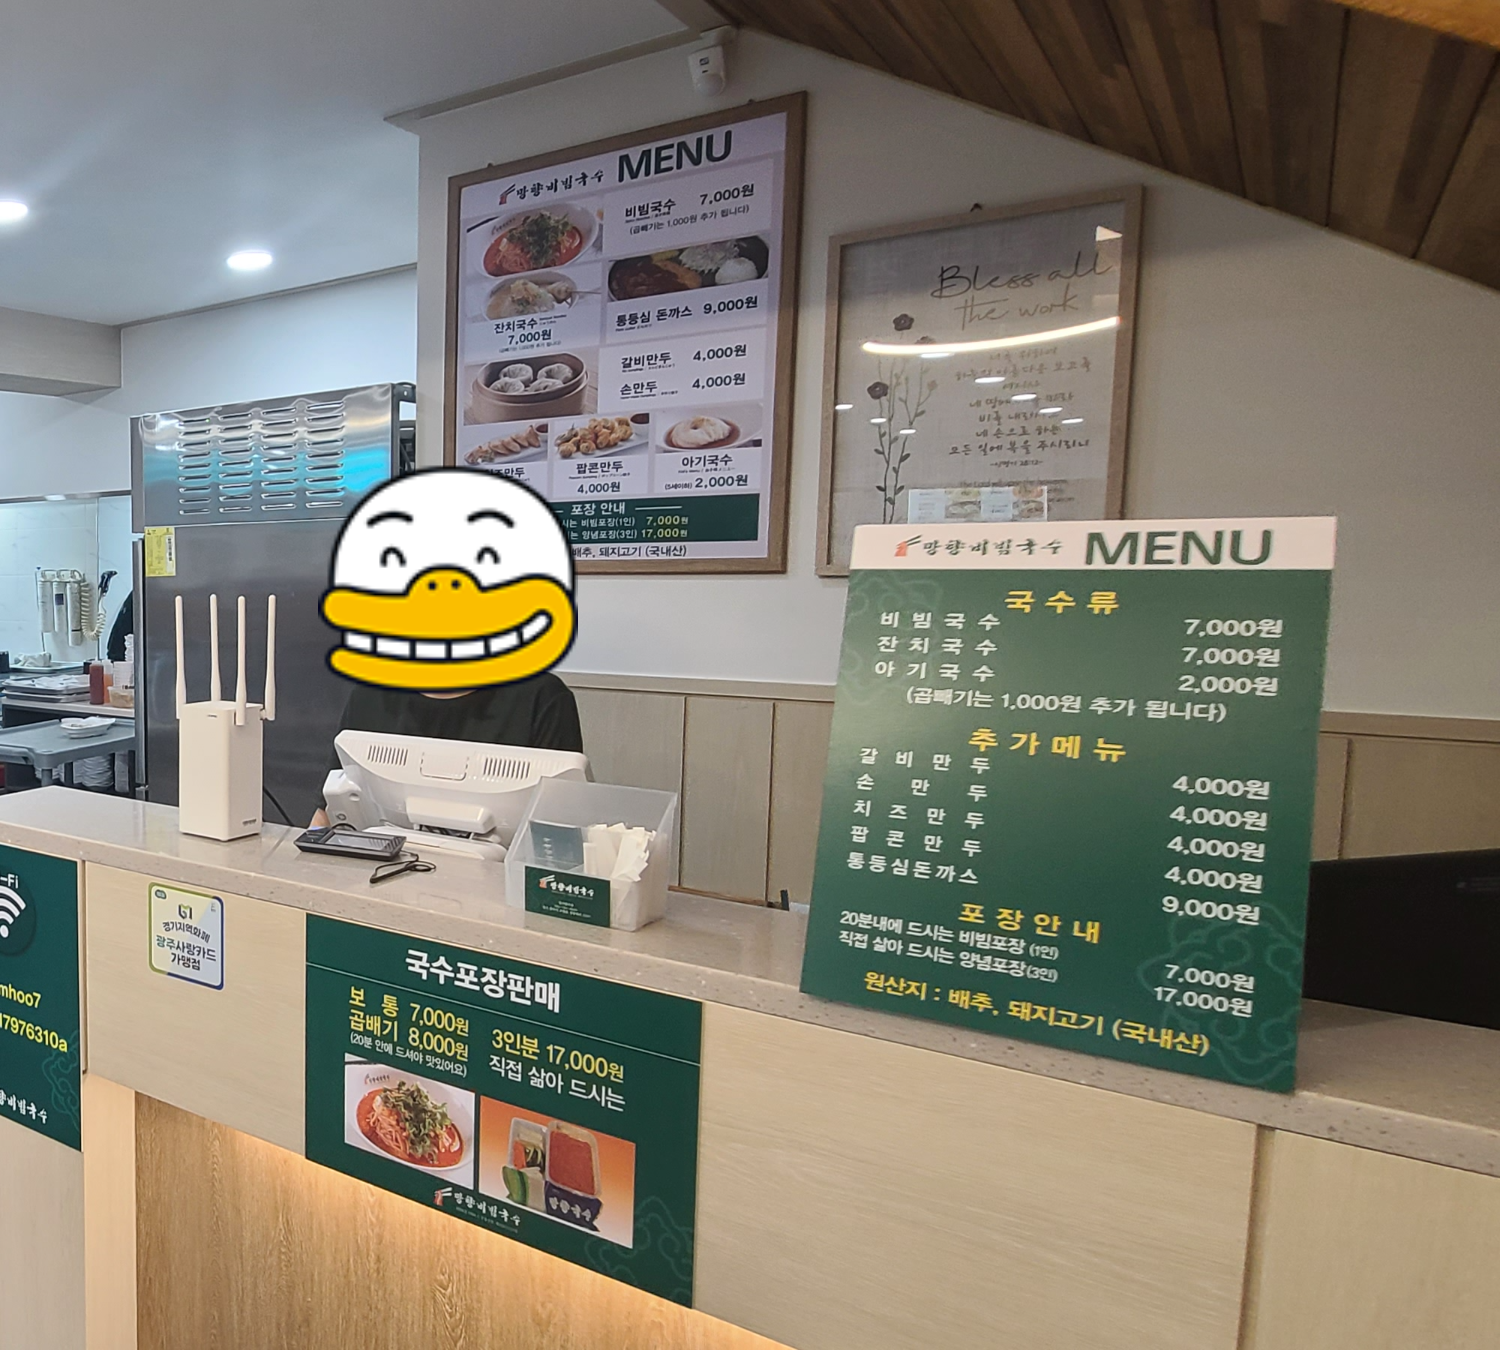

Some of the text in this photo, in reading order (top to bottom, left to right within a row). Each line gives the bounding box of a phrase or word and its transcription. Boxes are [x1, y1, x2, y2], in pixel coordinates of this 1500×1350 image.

[516, 129, 733, 200] 망향비빔국수 MENU
[625, 198, 676, 218] 비빔국수
[700, 183, 755, 206] 7,000원
[700, 211, 718, 222] 추가
[720, 204, 750, 218] 됩니다)
[930, 250, 1113, 298] Bless all
[615, 295, 758, 327] 통등심 돈까스 9,000원
[954, 282, 1078, 331] the work
[494, 318, 538, 334] 잔치국수
[508, 329, 552, 345] 7,000원
[621, 352, 672, 369] 갈비만두
[692, 344, 747, 362] 4,000원
[620, 381, 658, 396] 손만두
[692, 373, 746, 389] 4,000원
[576, 461, 624, 475] 팝콘만두
[681, 454, 733, 468] 아기국수
[577, 482, 621, 495] 4,000원
[695, 474, 748, 489] 2,000원
[571, 502, 626, 516] 포장 안내
[646, 515, 689, 527] 7,000원
[641, 528, 688, 539] 17,000원
[599, 545, 642, 557] 돼지고기
[645, 545, 687, 558] (국내산)
[922, 529, 1273, 566] 망향비빔국수 MENU
[1004, 590, 1120, 616] 국수류
[1184, 618, 1283, 638] 7,000원
[1181, 647, 1280, 667] 7,000원
[1178, 674, 1278, 697] 2,000원
[1000, 692, 1082, 714] 1,000원
[1088, 697, 1137, 717] 추가
[1145, 700, 1227, 723] 됩니다)
[1172, 776, 1270, 800] 4,000원
[1169, 805, 1268, 831] 4,000원
[1166, 836, 1265, 863] 4,000원
[846, 851, 1263, 894] 통등심돈까스 4,000원
[1161, 896, 1260, 926] 9,000원
[162, 921, 211, 944] 경기지역화폐
[839, 910, 1060, 961] 20분내에 드시는 비빔포장 (1인)
[156, 934, 217, 962] 광주사랑카드
[838, 930, 868, 950] 직접
[872, 935, 904, 956] 삶아
[906, 942, 956, 965] 드시는
[171, 952, 201, 971] 가맹점
[405, 948, 561, 1014] 국수포장판매
[409, 1002, 469, 1037] 7,000원
[863, 971, 928, 1001] 원산지
[1007, 1000, 1104, 1036] 돼지고기
[1112, 1018, 1211, 1057] (국내산)
[349, 1009, 468, 1062] 곱배기 8,000원
[350, 1031, 468, 1078] (20분 안에 드셔야 맛있어요)
[491, 1028, 624, 1084] 3인분 17,000원
[489, 1054, 626, 1112] 직접 삶아 드시는
